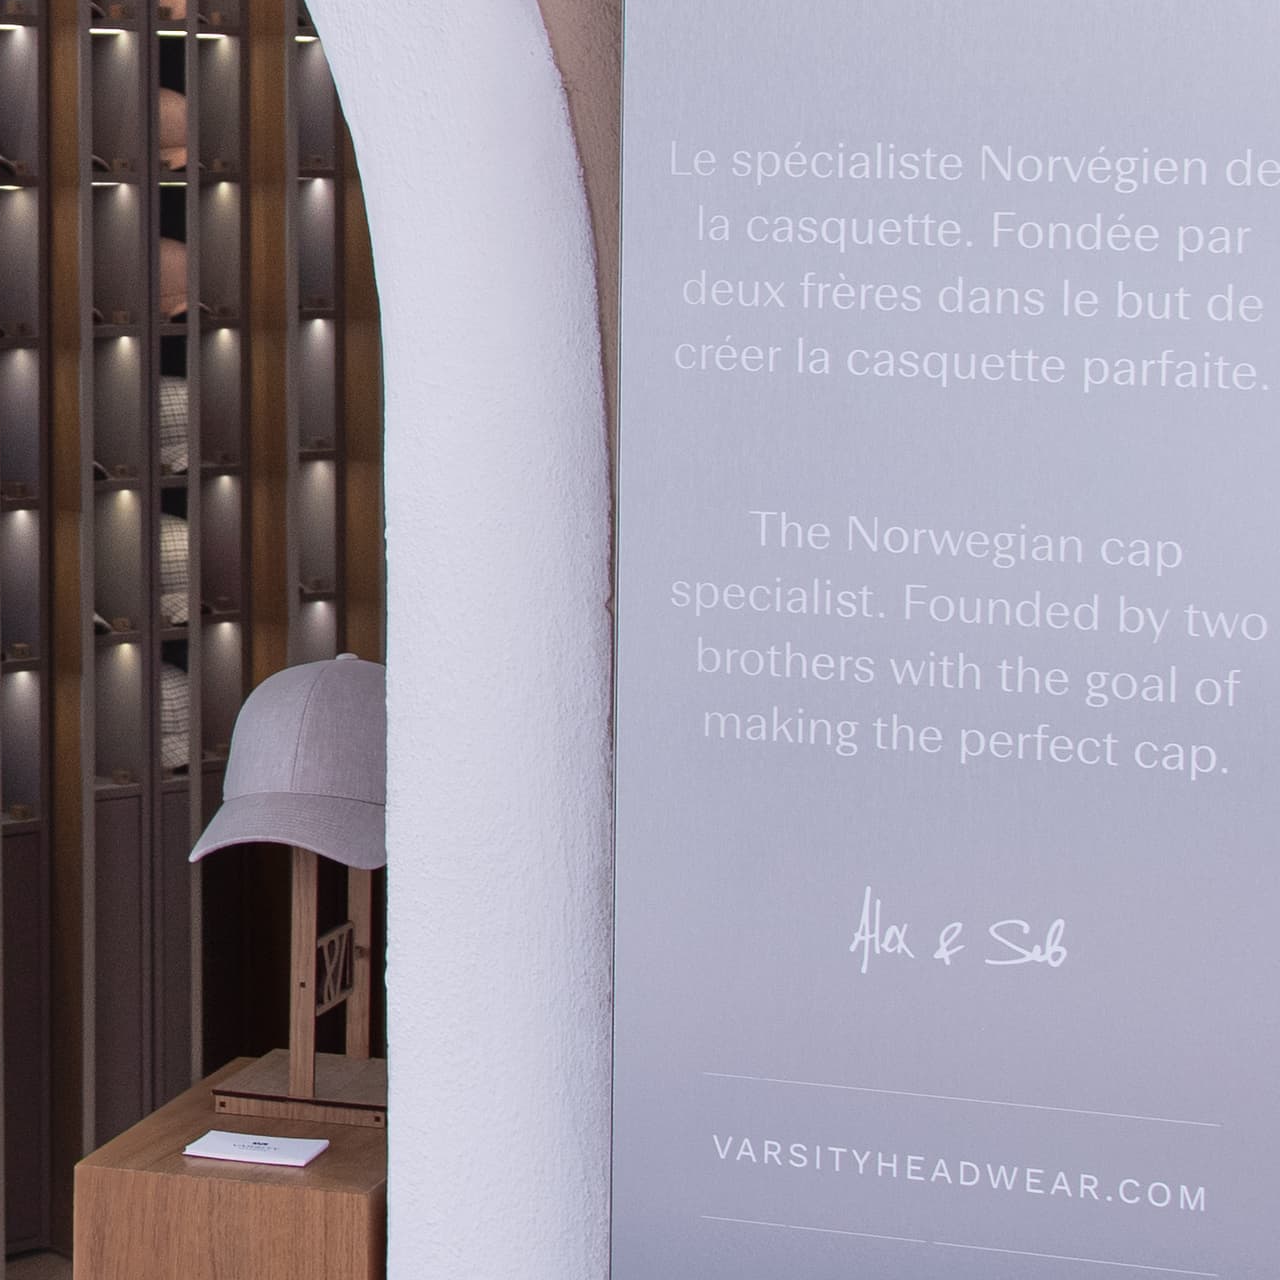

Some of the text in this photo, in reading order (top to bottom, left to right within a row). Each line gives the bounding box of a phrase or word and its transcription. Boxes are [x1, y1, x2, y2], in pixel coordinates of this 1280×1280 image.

[670, 140, 1280, 194] Le spécialiste Norvégien de
[698, 204, 1252, 262] la casquette. Fondée par
[682, 269, 1264, 323] deux frères dans le but de
[674, 335, 1269, 394] créer la casquette parfaite.
[749, 510, 1183, 577] The Norwegian cap
[670, 576, 1268, 644] specialist. Founded by two
[697, 636, 1241, 708] brothers with the goal of
[704, 705, 1228, 781] making the perfect cap.
[849, 885, 1068, 974] Alex & Seb
[712, 1134, 1206, 1212] VARSITYHEADWEAR.COM
